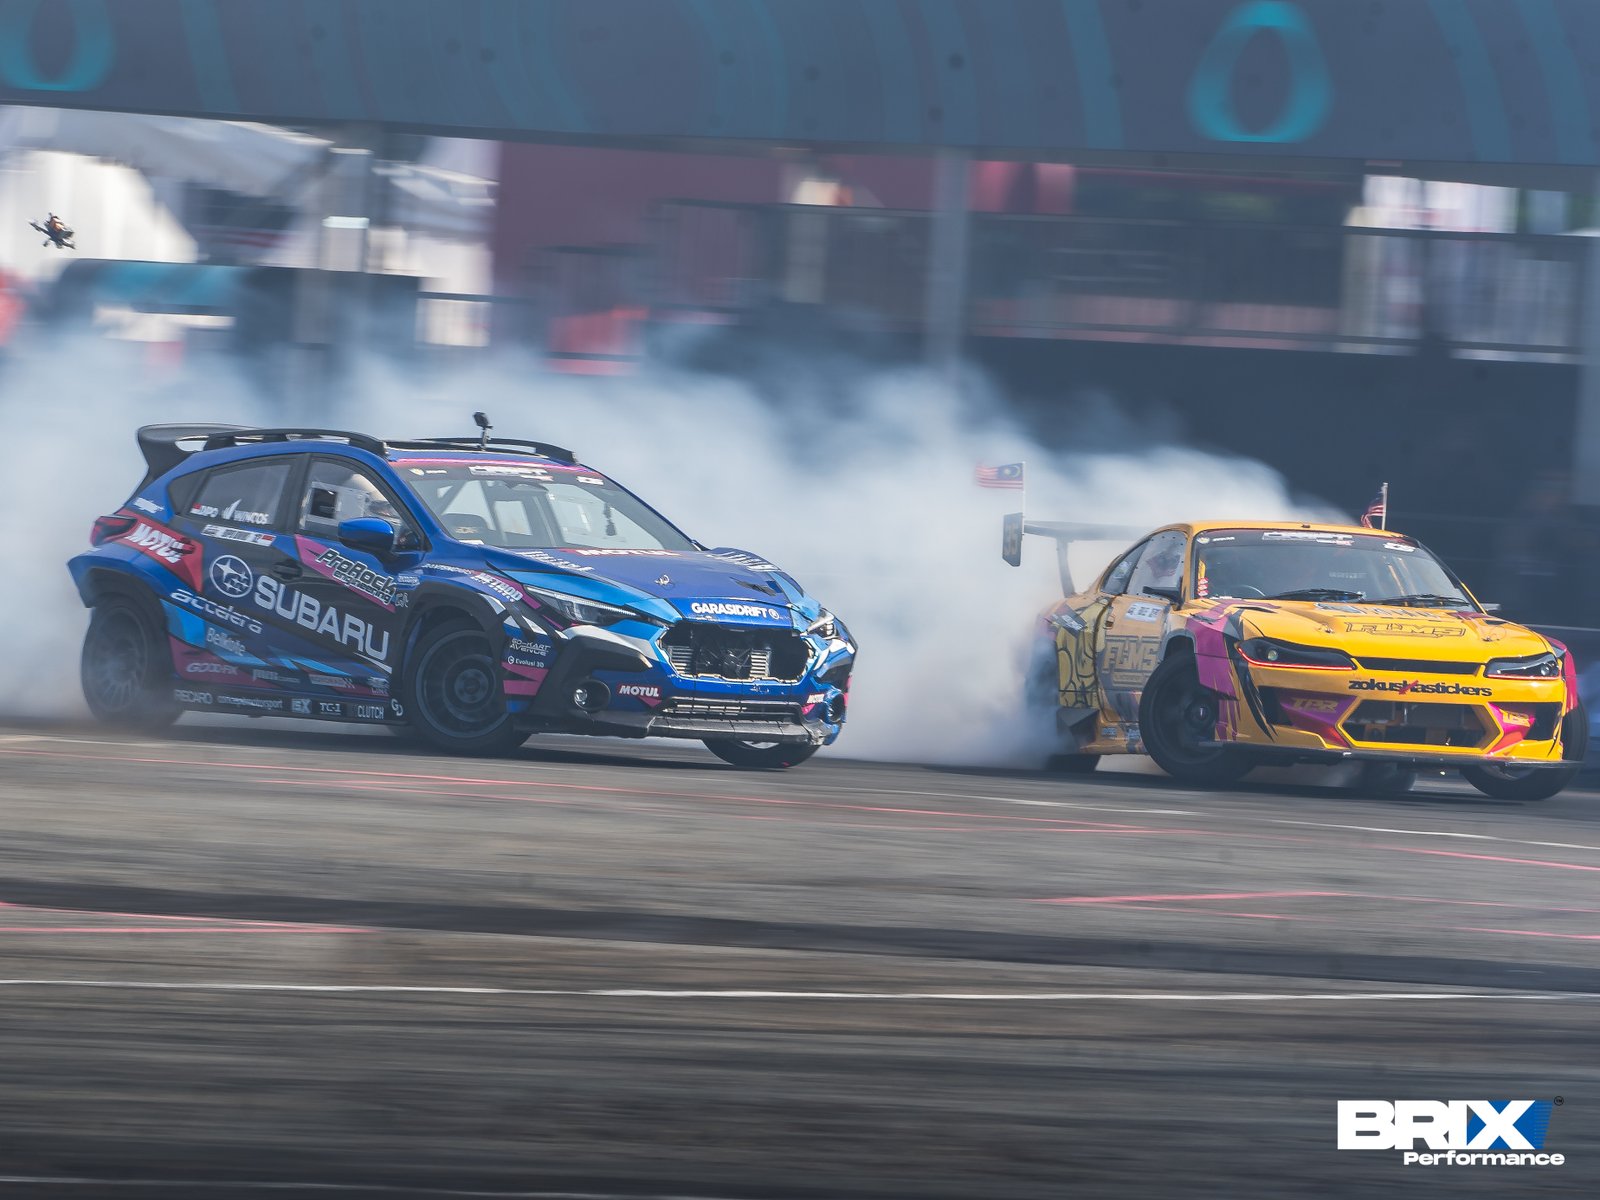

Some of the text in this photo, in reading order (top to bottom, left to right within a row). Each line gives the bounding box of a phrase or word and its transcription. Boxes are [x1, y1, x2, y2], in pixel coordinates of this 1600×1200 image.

[124, 522, 186, 563] MOTUL
[316, 547, 397, 596] ProRock
[332, 570, 393, 605] engineering
[170, 588, 264, 634] accelera
[254, 575, 390, 661] SUBARU
[691, 602, 767, 618] GARASIDRIFT
[510, 643, 548, 656] AVENUE
[515, 658, 536, 666] Evolusi
[619, 684, 660, 697] MOTUL
[357, 705, 385, 720] CLUTCH
